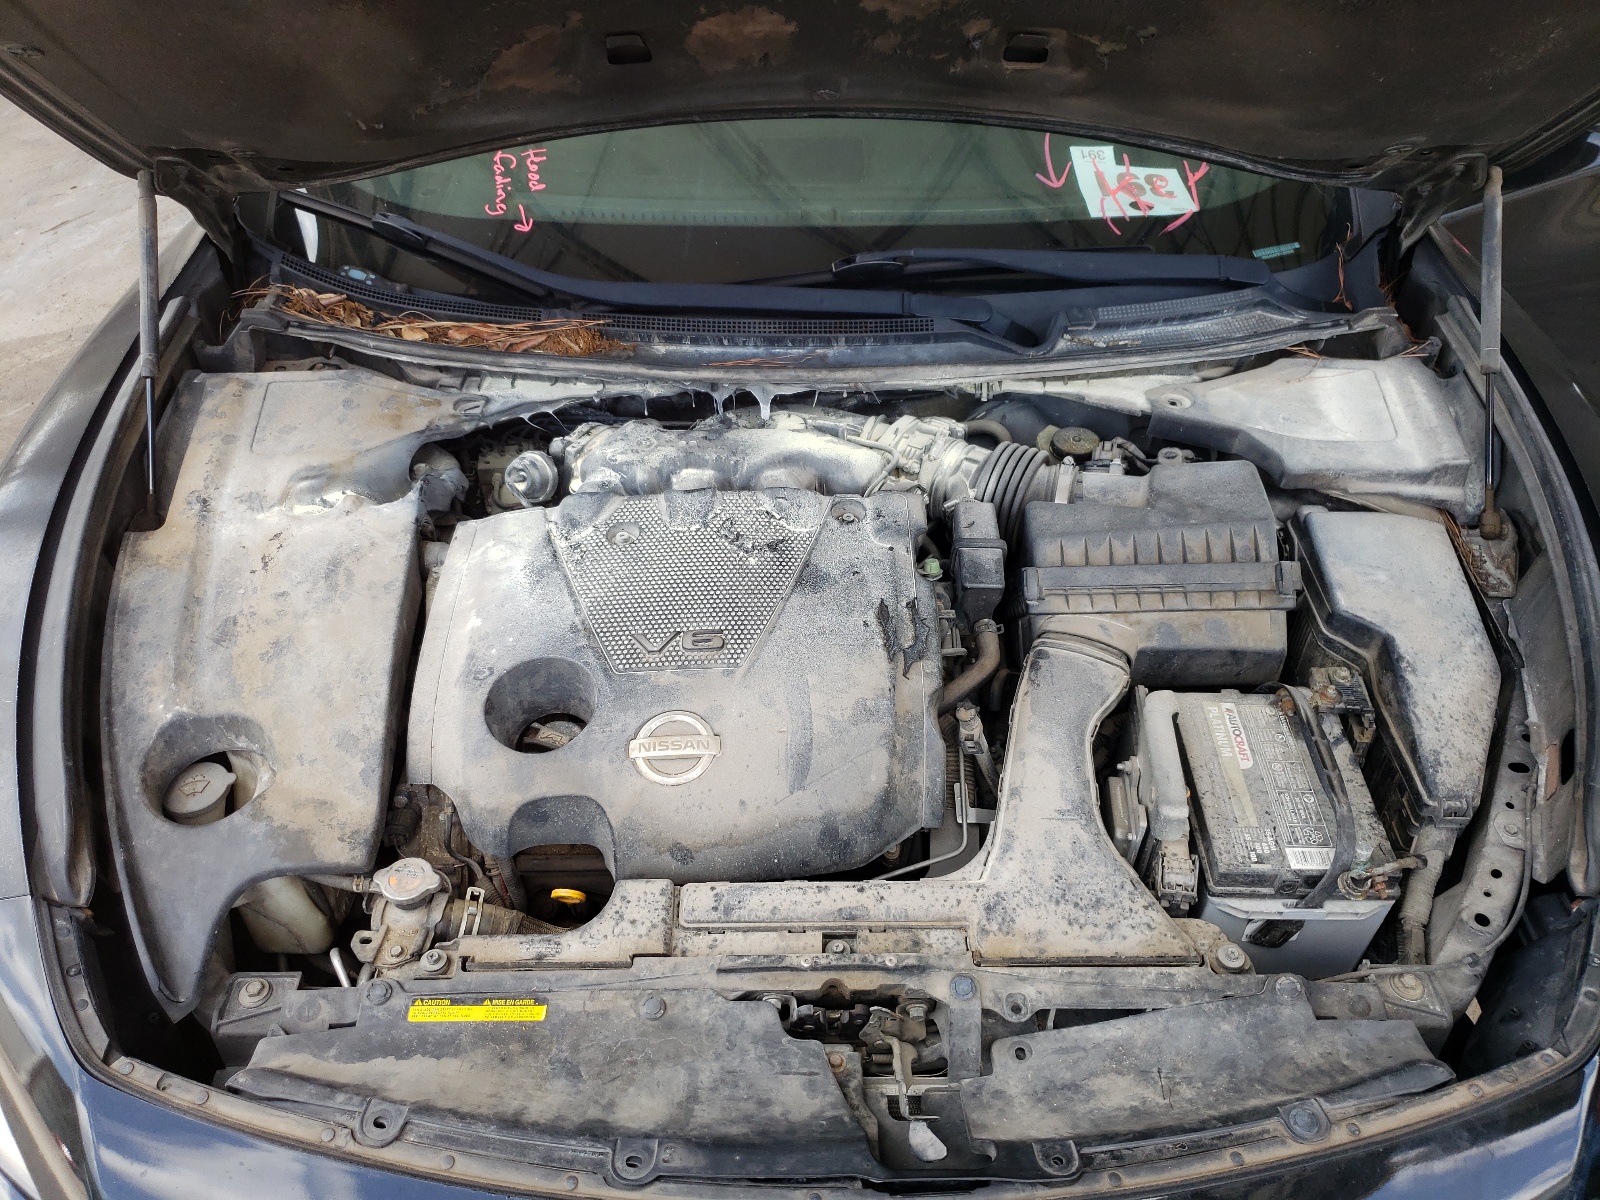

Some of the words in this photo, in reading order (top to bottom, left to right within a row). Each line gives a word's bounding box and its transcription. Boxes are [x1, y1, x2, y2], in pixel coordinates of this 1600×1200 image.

[521, 148, 547, 191] Hood
[1080, 149, 1106, 161] 391
[630, 628, 725, 655] V6
[638, 739, 710, 753] NISSAN
[1208, 706, 1233, 757] PLATINUM
[1226, 712, 1250, 762] AUTOCRAFT
